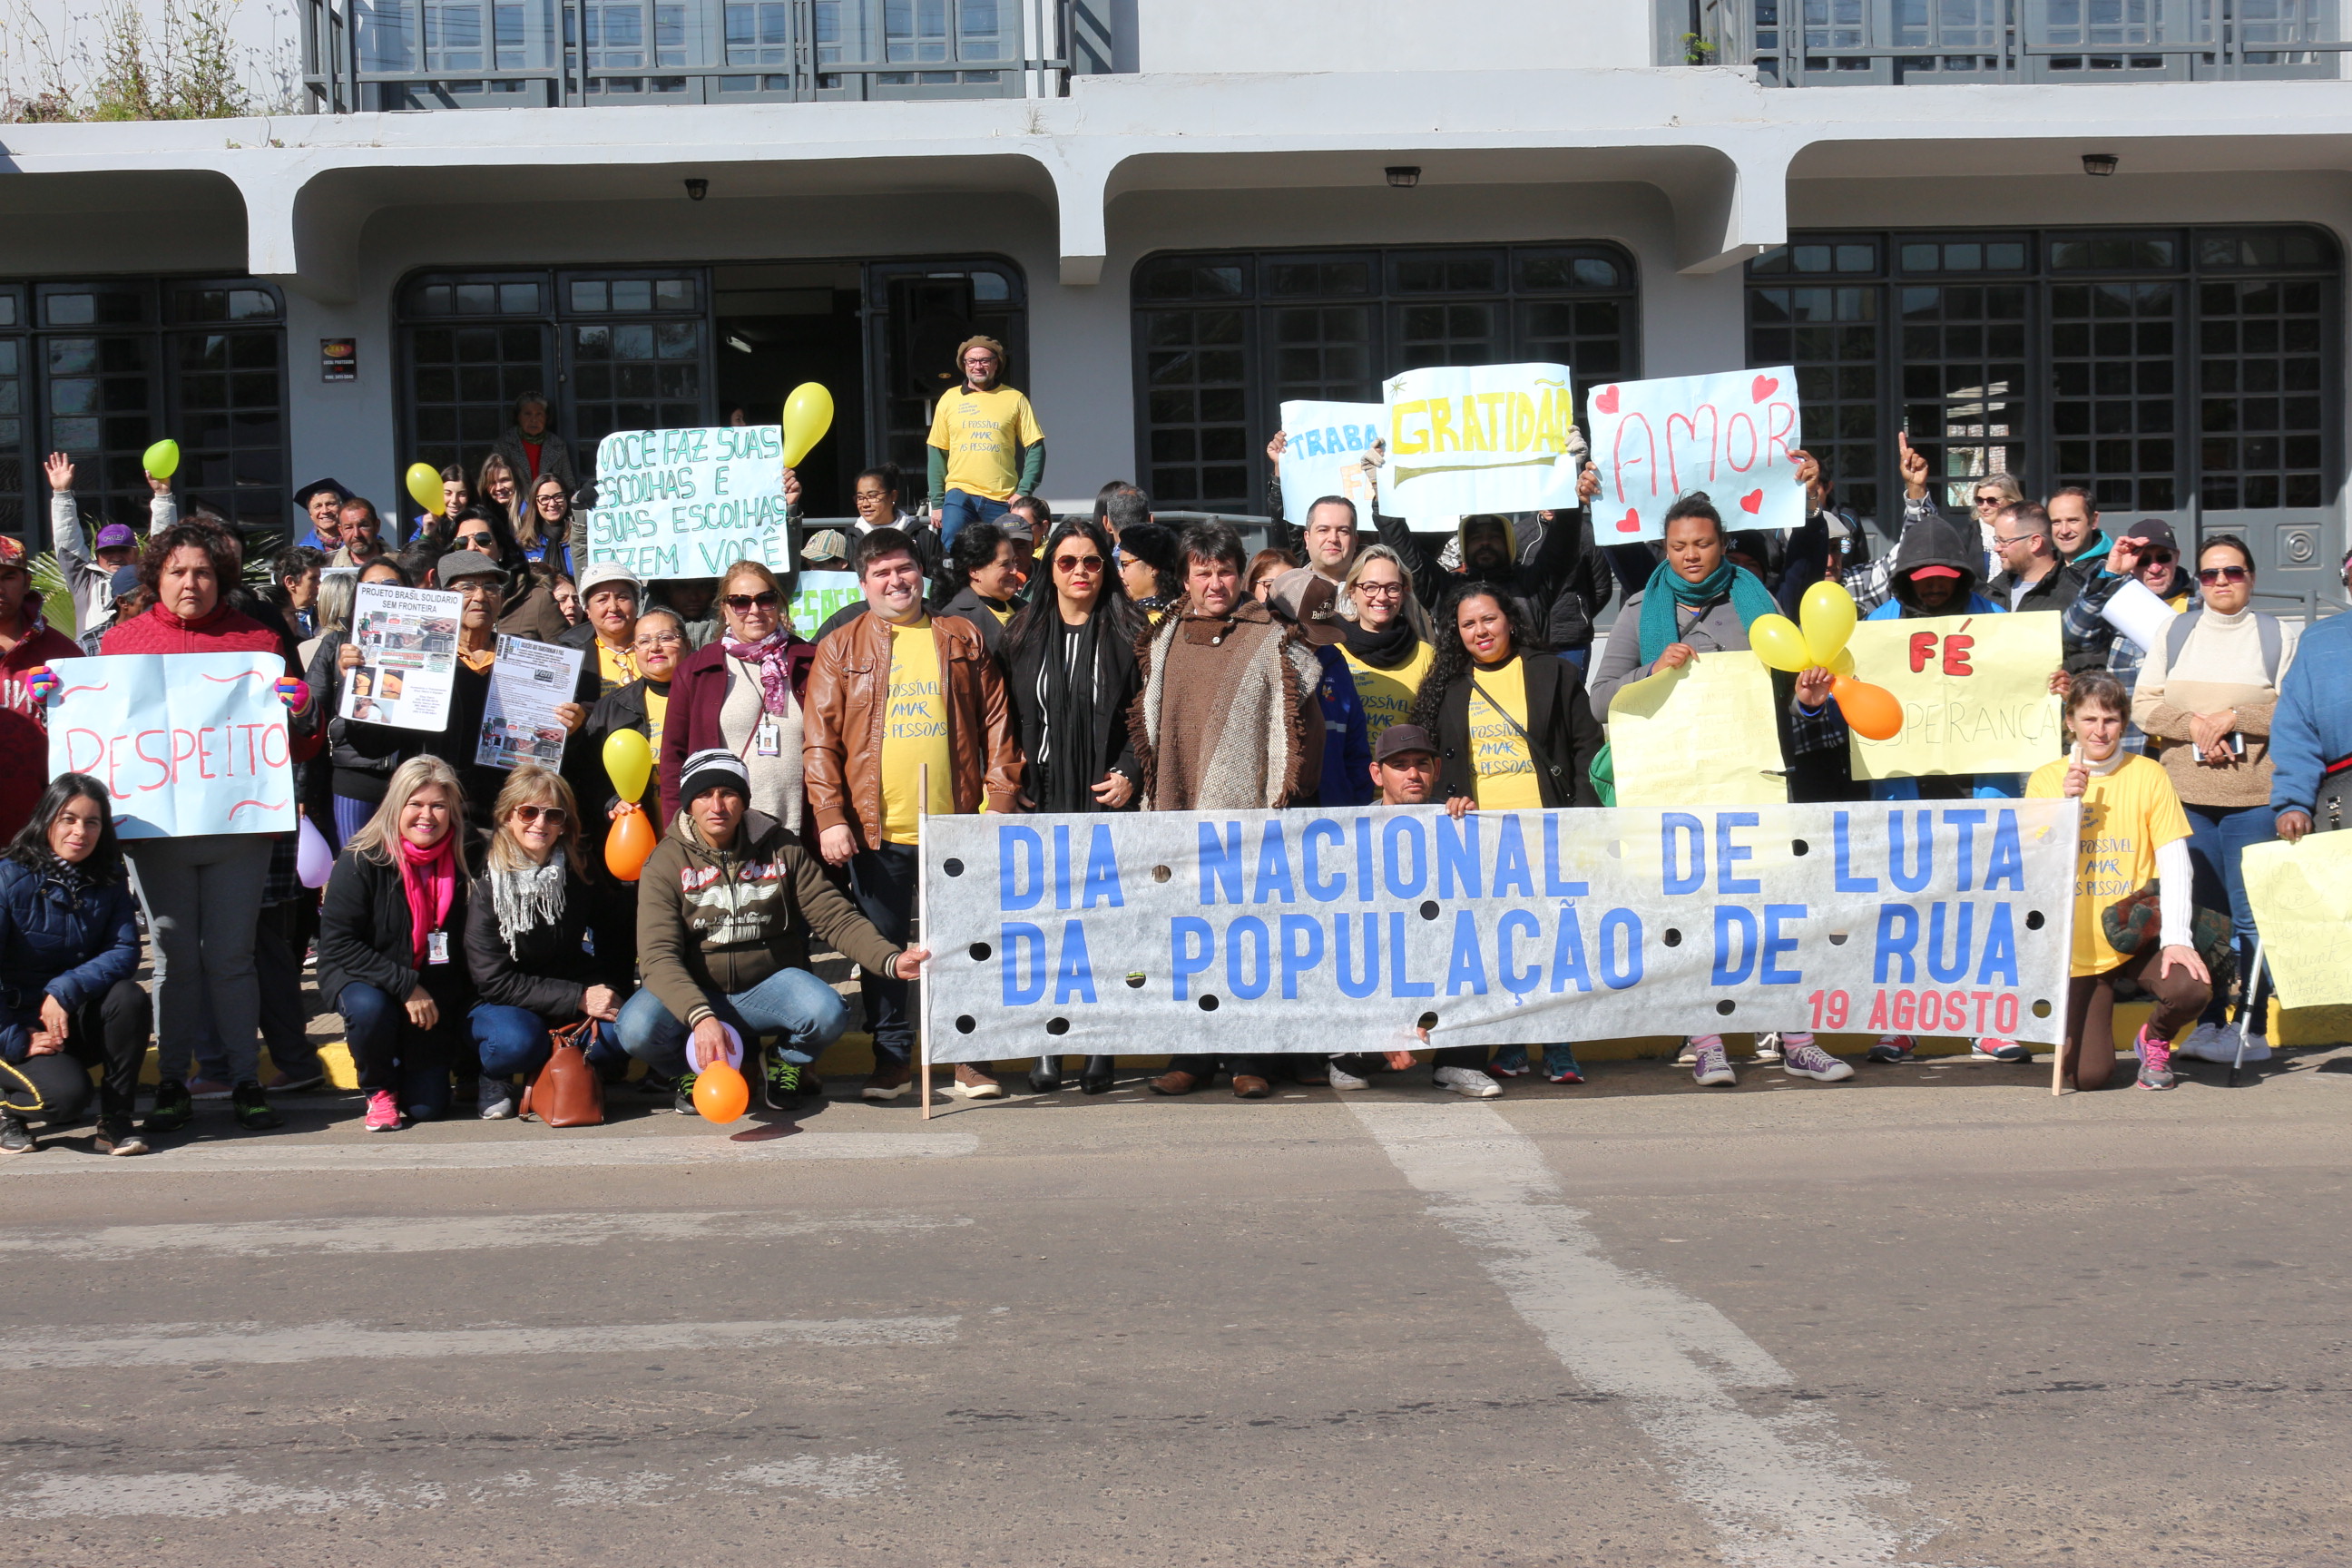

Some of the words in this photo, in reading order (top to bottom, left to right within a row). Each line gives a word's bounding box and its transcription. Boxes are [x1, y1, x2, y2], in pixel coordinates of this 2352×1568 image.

[968, 418, 1002, 431] POSSÍVEL
[1391, 377, 1573, 455] GRATIDÃO
[970, 431, 993, 442] AMAR
[1286, 423, 1379, 461] TRABA
[601, 429, 657, 472] VOCÊ
[664, 428, 708, 465] FAZ
[717, 426, 780, 462] SUAS
[959, 443, 968, 453] AS
[970, 442, 1001, 453] PESSOAS
[1613, 401, 1805, 504] AMOR
[715, 466, 730, 495] E
[593, 509, 658, 544] SUAS
[672, 495, 787, 534] ESCOLHAS
[699, 525, 782, 574] VOCÊ
[362, 586, 394, 598] PROJETO
[395, 590, 419, 601] BRASIL
[421, 593, 458, 604] SOLIDÁRIO
[382, 600, 397, 609] SEM
[398, 602, 437, 613] FRONTEIRA
[1909, 617, 1975, 676] FÉ
[891, 701, 933, 718] AMAR
[1360, 693, 1412, 714] OSSÍVEL
[1367, 712, 1395, 727] MAR
[1857, 702, 2058, 746] PERANÇA
[892, 721, 947, 739] PESSOAS
[1478, 741, 1519, 758] AMAR
[1481, 760, 1534, 776] PESSOAS
[2080, 835, 2135, 854] POSSÍVEL
[998, 824, 1124, 911] DIA
[1198, 812, 1589, 906] NACIONAL
[1661, 812, 1761, 896] DE
[1833, 808, 2024, 893] LUTA
[2085, 858, 2123, 877] AMAR
[2087, 880, 2136, 897] PESSOAS
[1001, 919, 1098, 1006] DA
[1171, 899, 1643, 1007] POPULAÇÃO
[1711, 904, 1808, 986] DE
[1873, 901, 2019, 987] RUA
[1808, 989, 1849, 1029] 19
[1867, 988, 2018, 1034] AGOSTO
